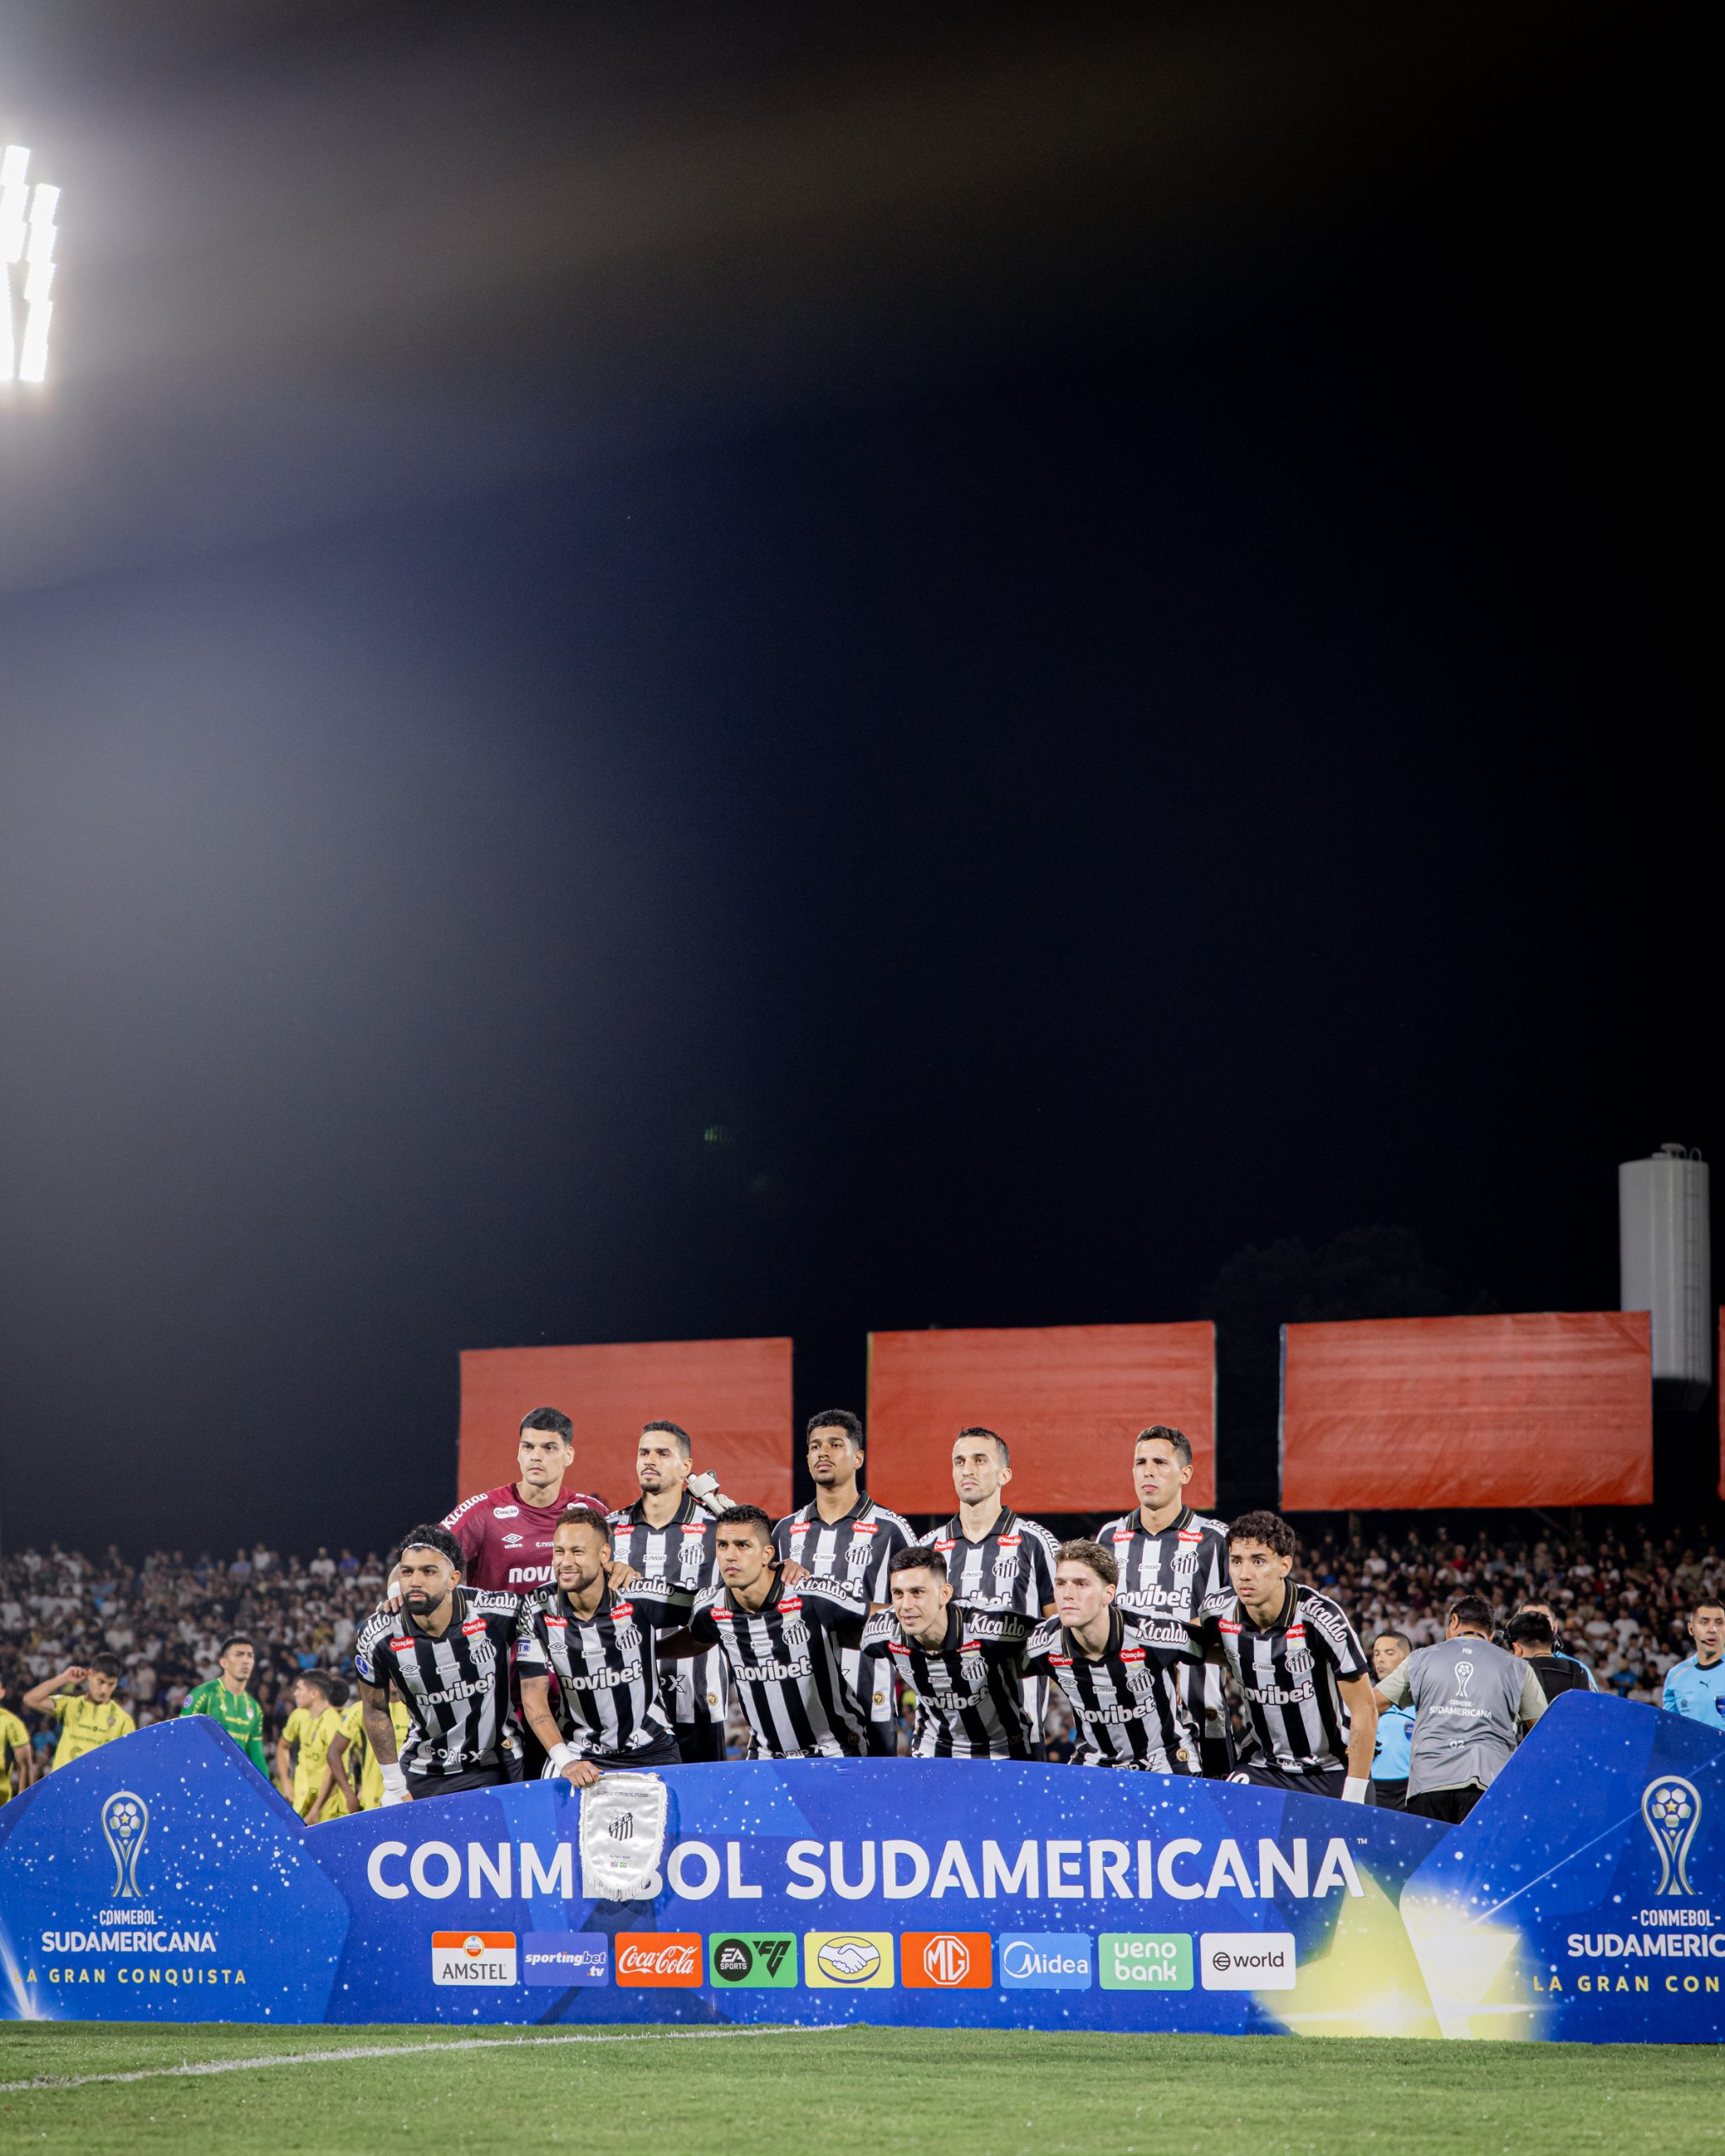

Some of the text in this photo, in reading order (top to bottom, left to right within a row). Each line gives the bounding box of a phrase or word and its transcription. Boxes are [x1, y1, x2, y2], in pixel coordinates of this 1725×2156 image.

[494, 1507, 518, 1518] Canção
[682, 1524, 706, 1534] Canção
[853, 1524, 877, 1533] Canção
[1114, 1532, 1134, 1540] Canção
[1179, 1533, 1202, 1541] Canção
[935, 1540, 954, 1550] Canção
[998, 1536, 1021, 1545] Canção
[794, 1574, 846, 1600] Kicaldo
[474, 1592, 520, 1609] Kicald
[1116, 1584, 1192, 1608] novibet
[610, 1605, 632, 1617] Canção
[778, 1601, 801, 1611] Canção
[462, 1621, 486, 1632] Canção
[969, 1612, 1025, 1637] Kicaldo
[1220, 1621, 1241, 1631] Canção
[1301, 1595, 1348, 1642] Kicaldo
[356, 1614, 391, 1658] Kicaldo
[1137, 1618, 1188, 1644] Kicaldo
[390, 1639, 414, 1648] Canção
[1121, 1651, 1145, 1661] Canção
[560, 1659, 643, 1691] novibet
[734, 1656, 813, 1682] novibet
[415, 1673, 495, 1705] novibet
[921, 1685, 989, 1710] ovibet
[1076, 1696, 1156, 1724] novibet
[1429, 1706, 1492, 1718] SUDAMERICANA
[1450, 1740, 1466, 1749] 02
[366, 1839, 763, 1900] CONMOL
[785, 1838, 1365, 1900] SUDAMERICANA
[42, 1931, 216, 1952] SUDAMERICANA
[1567, 1933, 1725, 1957] SUDAMERIC
[525, 1951, 606, 1966] sportingbet
[721, 1948, 745, 1962] EA
[1114, 1942, 1177, 1959] ueno
[1233, 1951, 1284, 1967] world
[618, 1945, 698, 1974] Coca-Cola
[927, 1940, 965, 1981] MG
[1016, 1953, 1088, 1974] Midea
[49, 1968, 105, 1983] GRAN
[117, 1968, 246, 1986] CONQUISTA
[442, 1963, 507, 1980] AMSTEL
[1114, 1959, 1177, 1981] bank
[1533, 1976, 1720, 1993] LA GRAN CON
